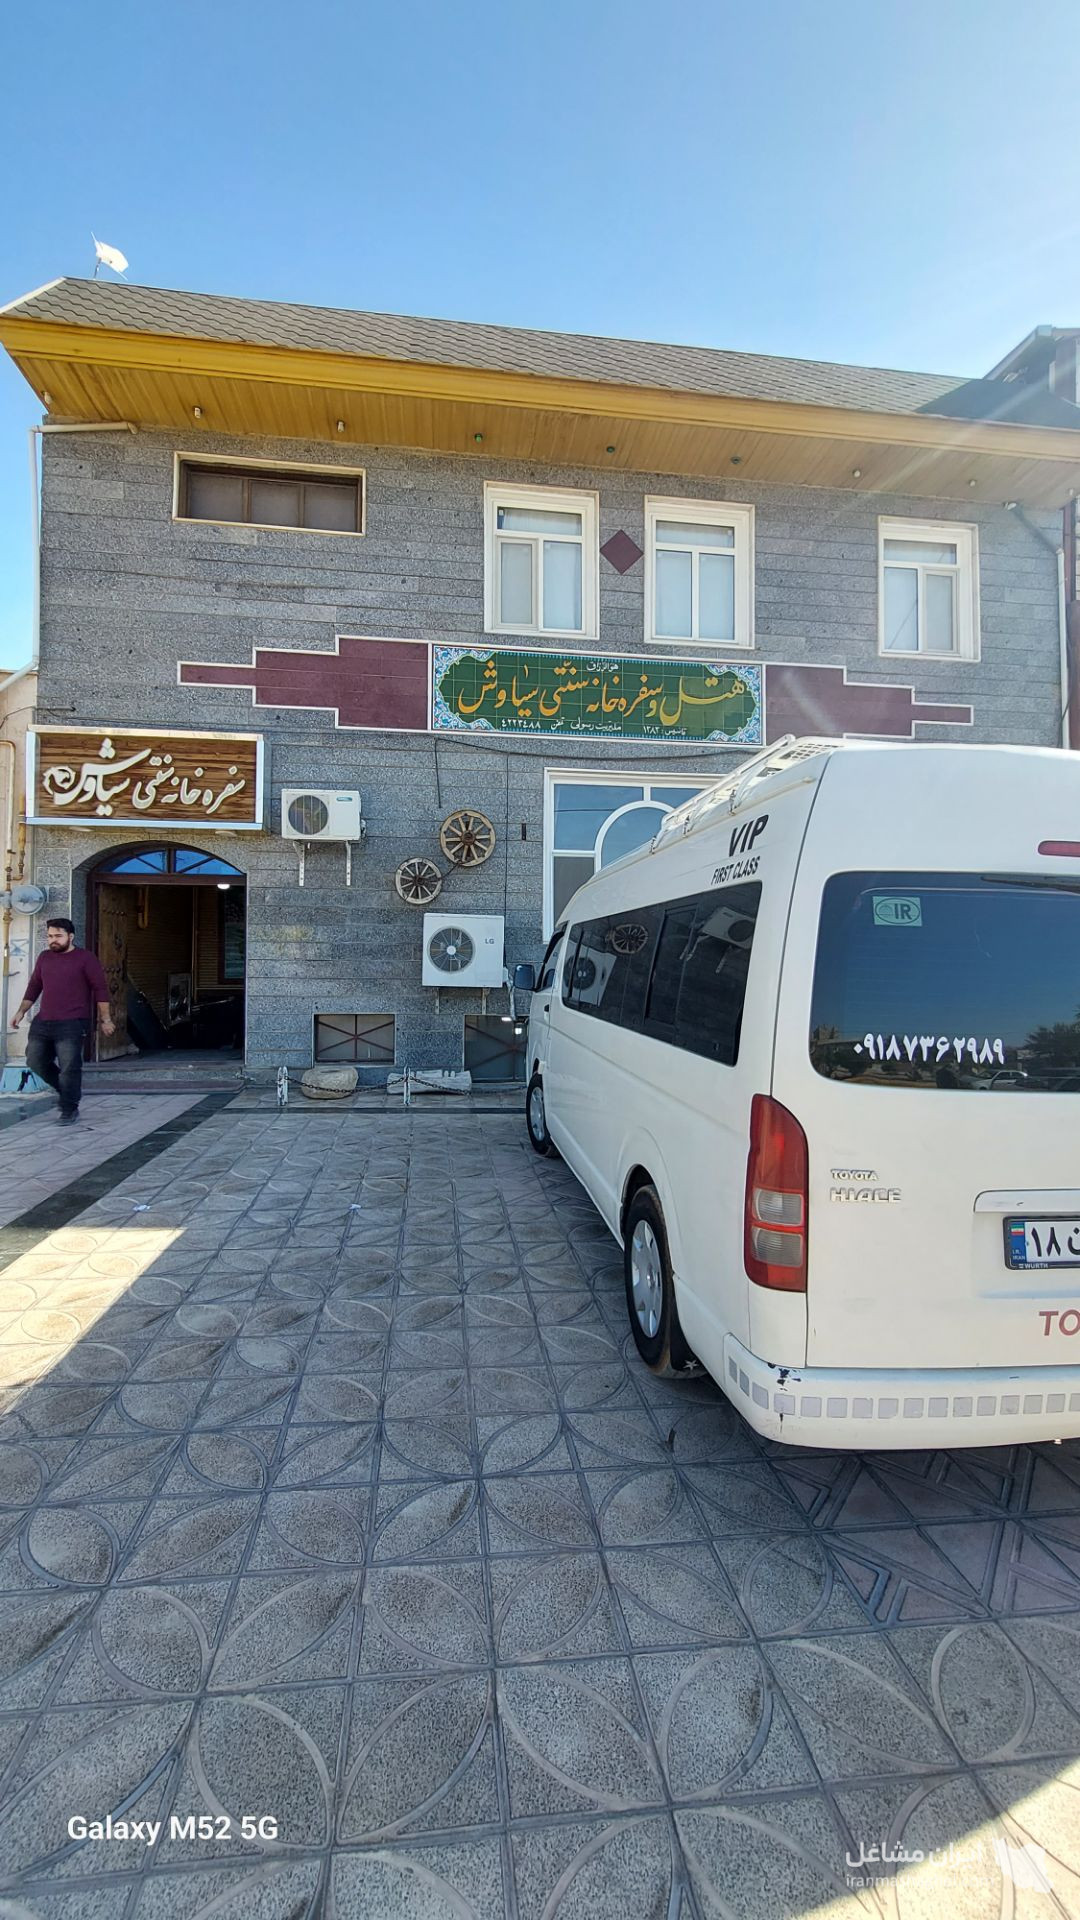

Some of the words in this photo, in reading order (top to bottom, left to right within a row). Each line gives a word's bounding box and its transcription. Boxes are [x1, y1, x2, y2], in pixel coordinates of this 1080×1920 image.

[457, 659, 540, 717] سیاوش
[539, 660, 590, 716] سنتی
[659, 675, 745, 726] هتل
[43, 737, 152, 816] سیاوش
[132, 754, 175, 809] سنتی
[202, 766, 246, 814] سفره
[729, 814, 769, 857] VIP
[711, 863, 735, 885] FIRST
[732, 856, 760, 880] CLASS
[895, 903, 912, 920] IR
[830, 1168, 879, 1181] TOYOTA
